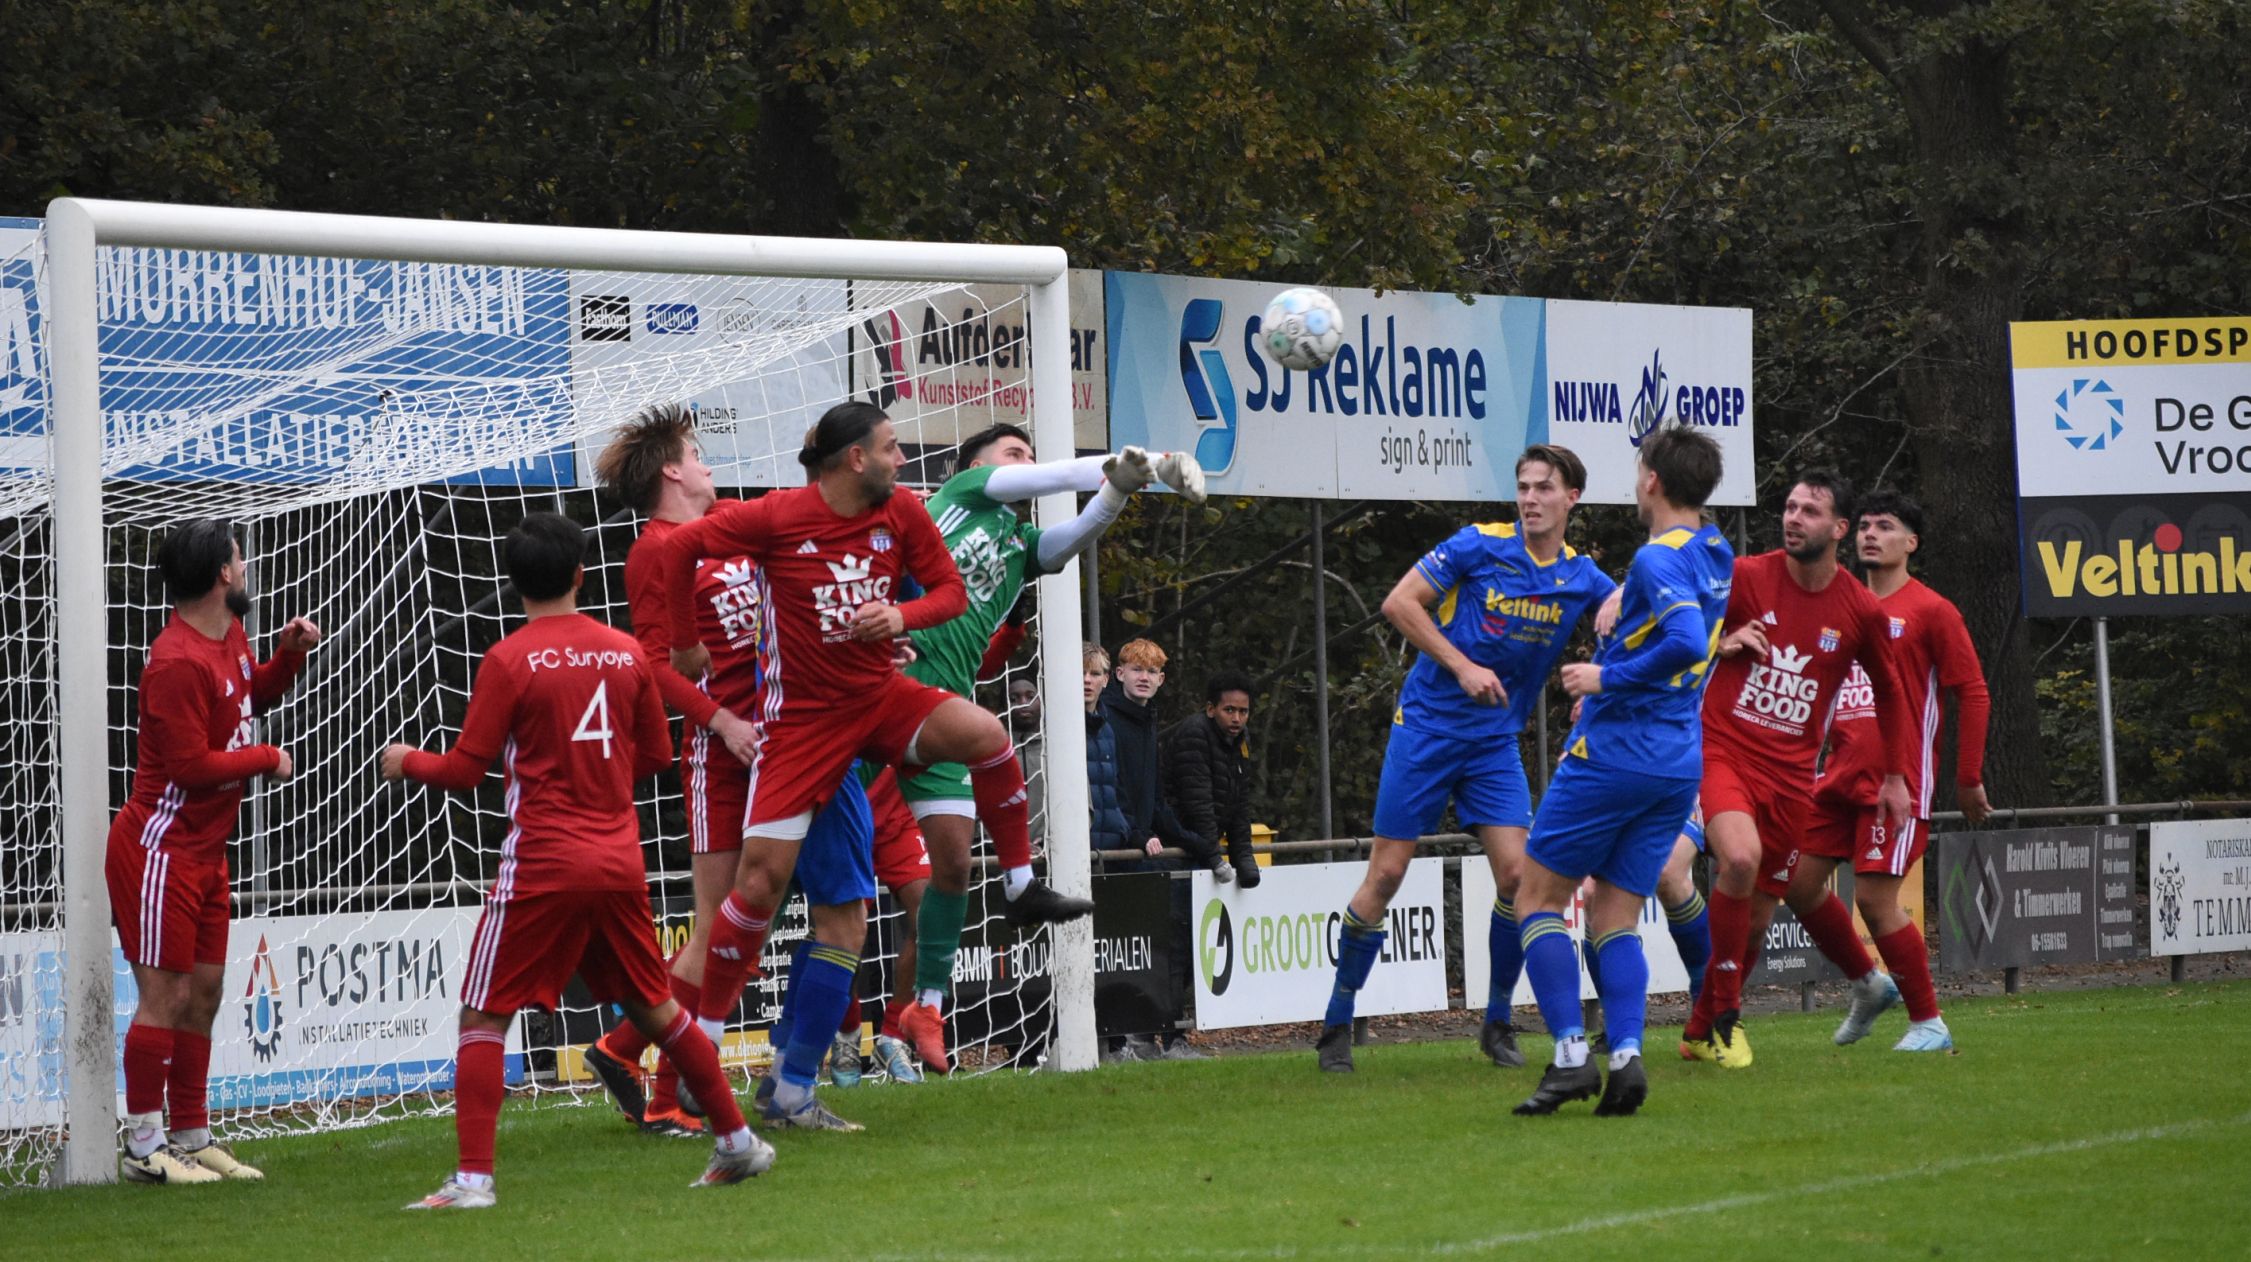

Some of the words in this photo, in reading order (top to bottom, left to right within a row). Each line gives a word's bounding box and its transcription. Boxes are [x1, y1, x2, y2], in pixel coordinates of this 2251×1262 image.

[919, 307, 1097, 372] Aufderar
[2066, 327, 2248, 360] HOOFDSP
[1308, 314, 1486, 419] Reklame
[919, 376, 989, 407] Kunststof
[1555, 381, 1622, 424] NIJWA
[1677, 386, 1744, 427] GROEP
[700, 408, 737, 419] HILDING
[2155, 398, 2214, 432] De
[1381, 429, 1411, 473] sign
[1417, 432, 1431, 467] &
[1434, 433, 1473, 475] print
[2037, 524, 2251, 598] Veltink
[709, 580, 760, 617] KIN
[811, 576, 891, 611] KING
[1485, 587, 1563, 624] Veltink
[527, 648, 561, 673] FC
[564, 647, 634, 671] Suryoye
[1747, 661, 1819, 702] KING
[1836, 686, 1876, 710] FOO
[571, 678, 613, 760] 4
[1737, 683, 1812, 724] FOOD
[1871, 826, 1886, 845] 13
[1787, 849, 1799, 867] 8
[1766, 912, 1818, 950] service
[2193, 897, 2251, 937] TEMM
[1242, 906, 1437, 974] GROOTGENER
[297, 938, 446, 1008] POSTMA
[955, 946, 993, 983] BMN
[1011, 936, 1151, 979] BOUWERIALEN
[299, 1018, 428, 1044] NSTALLATIEECHNIEK
